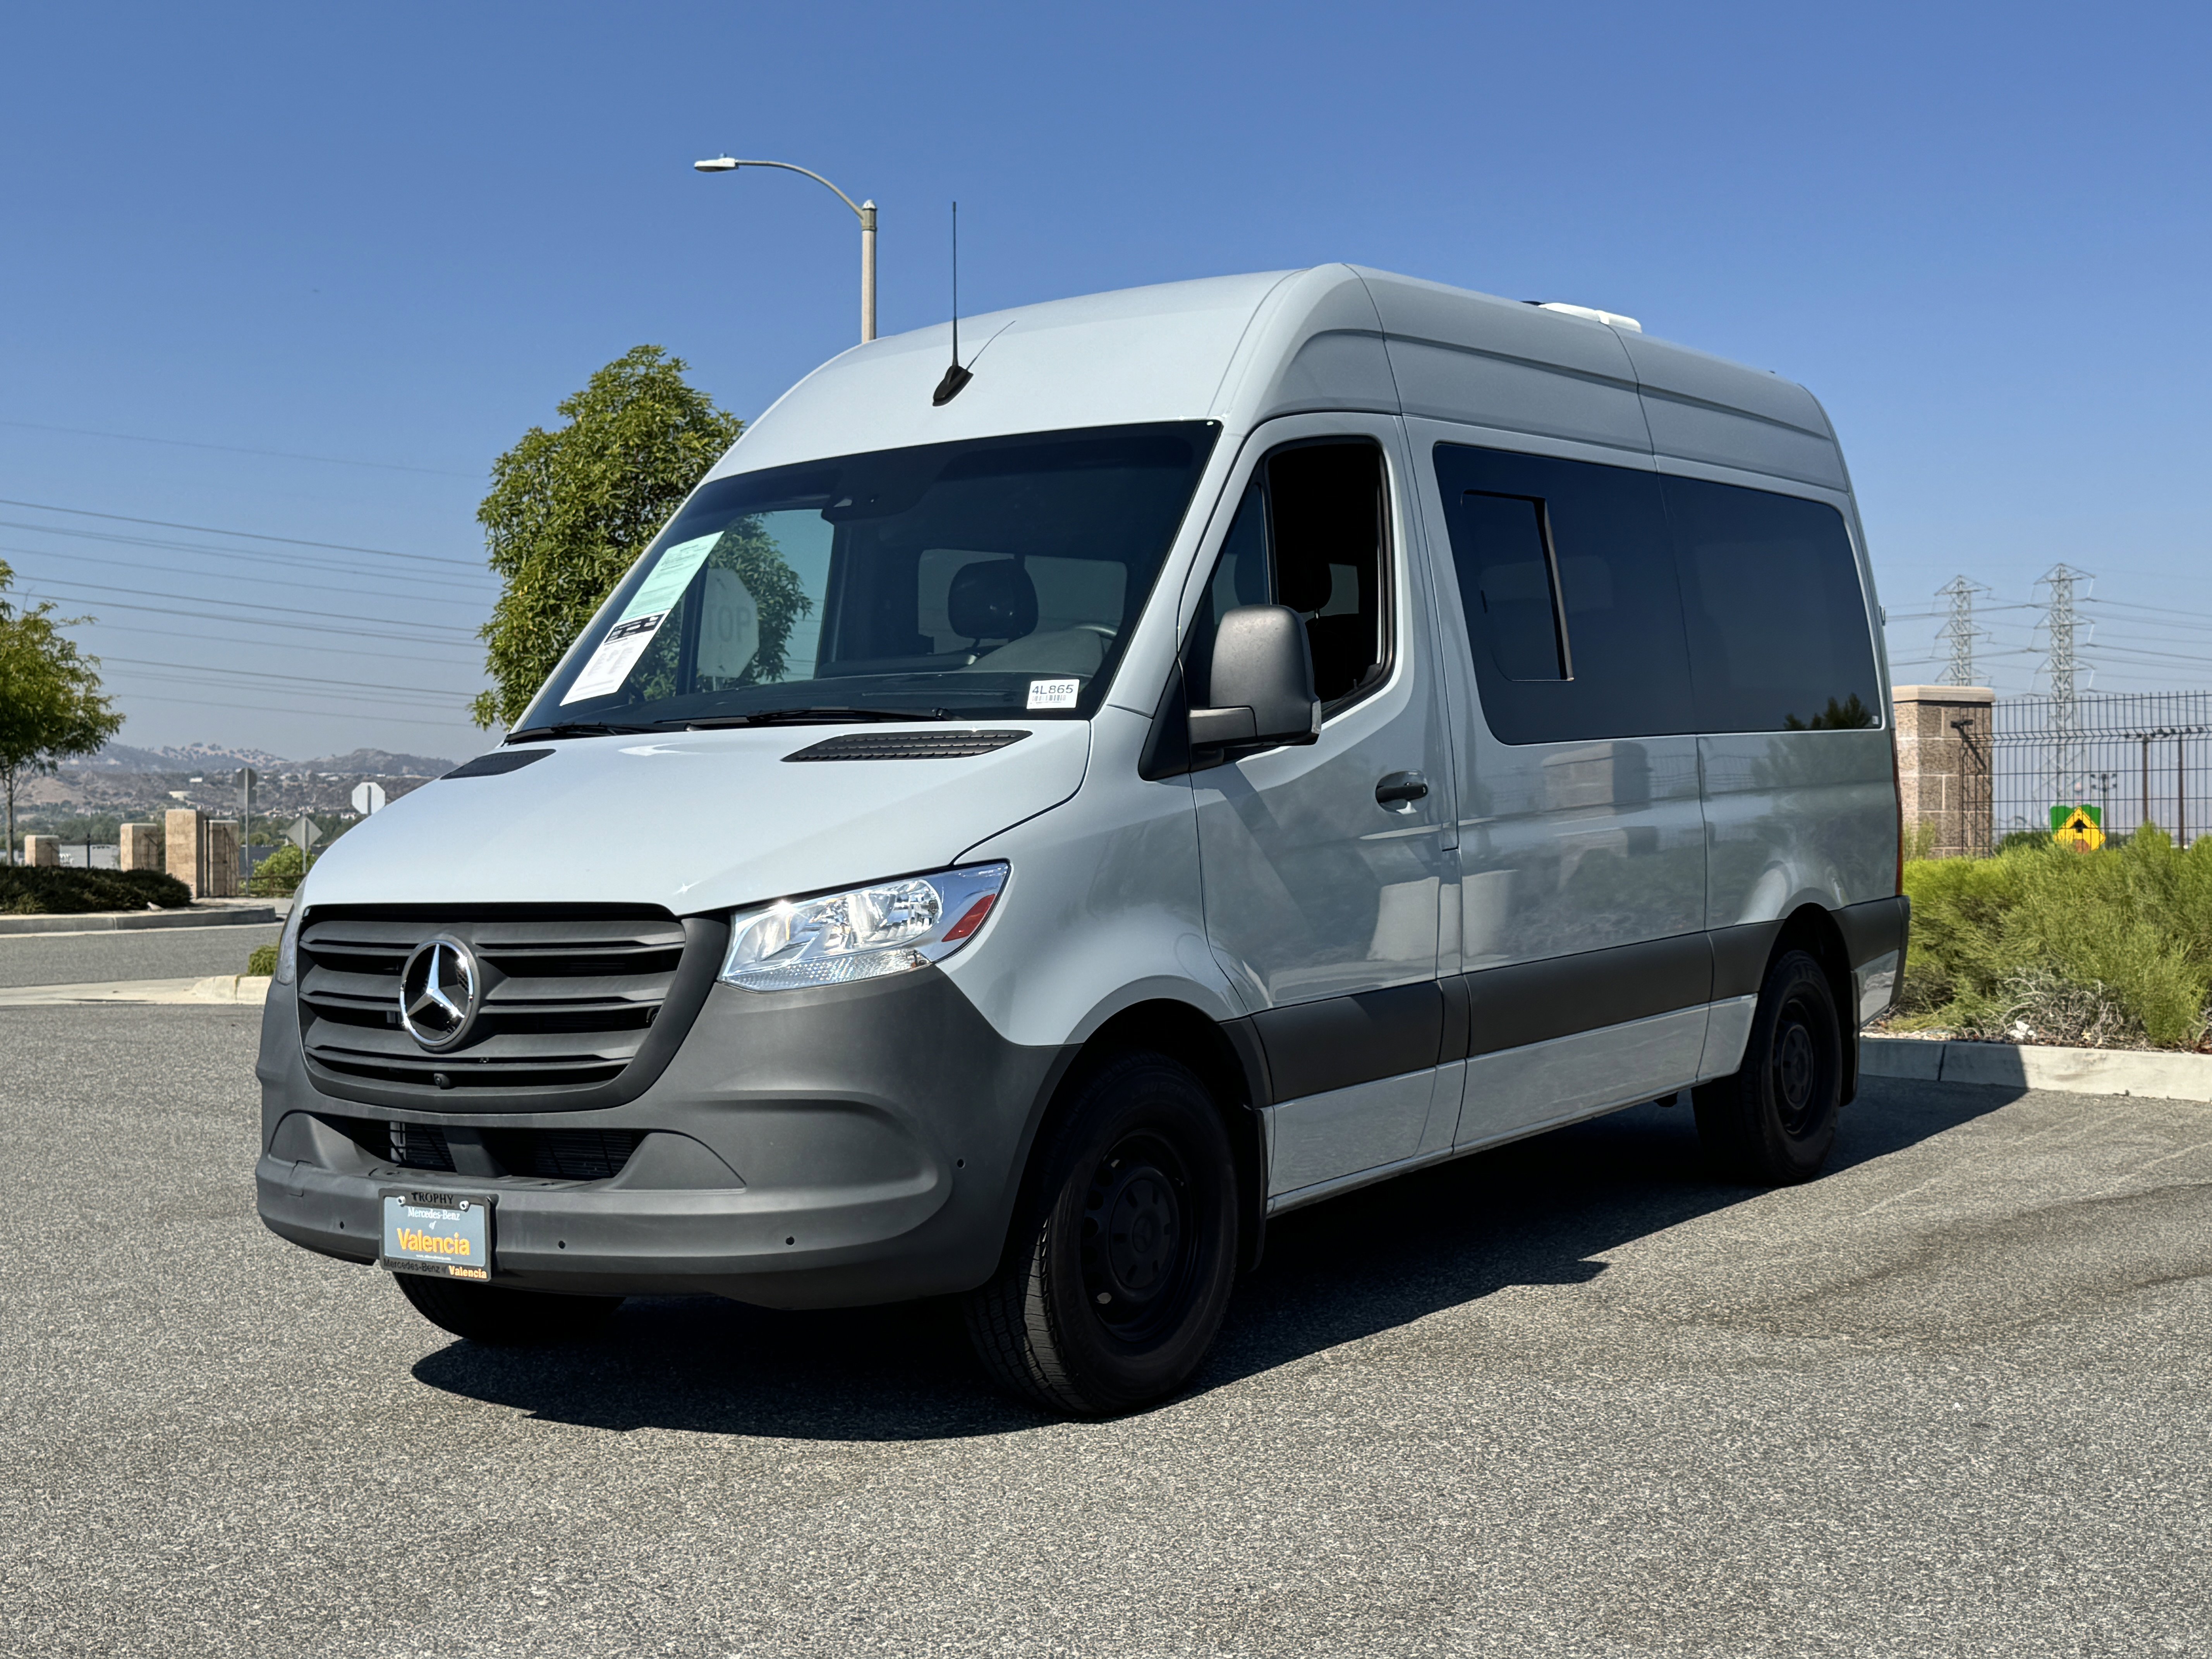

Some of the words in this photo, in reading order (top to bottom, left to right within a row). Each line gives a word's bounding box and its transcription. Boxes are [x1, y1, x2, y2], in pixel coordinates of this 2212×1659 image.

[705, 603, 751, 642] TOP
[1032, 684, 1074, 694] 4L865
[411, 1192, 453, 1204] TROPHY
[408, 1207, 460, 1221] Mercedes-Benz
[397, 1228, 471, 1255] Valencia
[384, 1258, 440, 1273] Mercedes-Benz
[449, 1265, 487, 1279] Valencia
